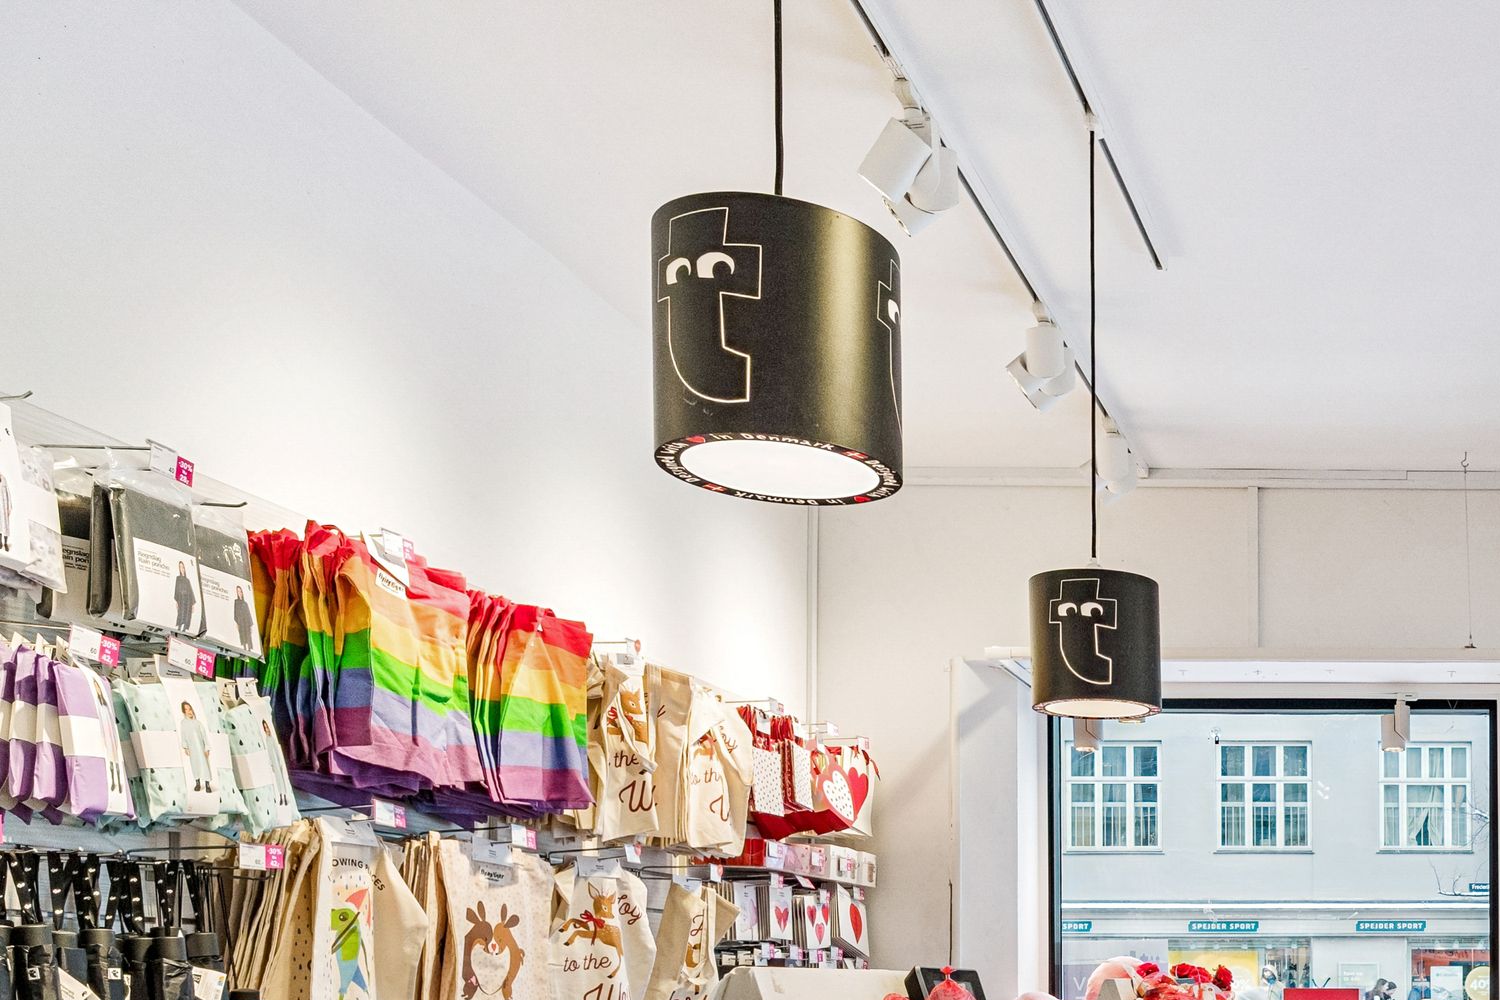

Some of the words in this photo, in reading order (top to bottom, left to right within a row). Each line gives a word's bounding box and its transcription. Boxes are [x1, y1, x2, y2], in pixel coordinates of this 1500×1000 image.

[740, 432, 835, 451] Denmark
[62, 548, 90, 558] egnslag
[101, 640, 118, 651] -30%
[197, 652, 213, 664] -30%
[267, 847, 282, 856] -30%
[1062, 922, 1089, 930] SPORT
[1191, 922, 1228, 930] SPEJDER
[1229, 922, 1256, 930] SPORT
[1359, 922, 1395, 930] SPEJDER
[1396, 922, 1424, 930] SPORT
[563, 955, 580, 973] to
[583, 953, 613, 971] the
